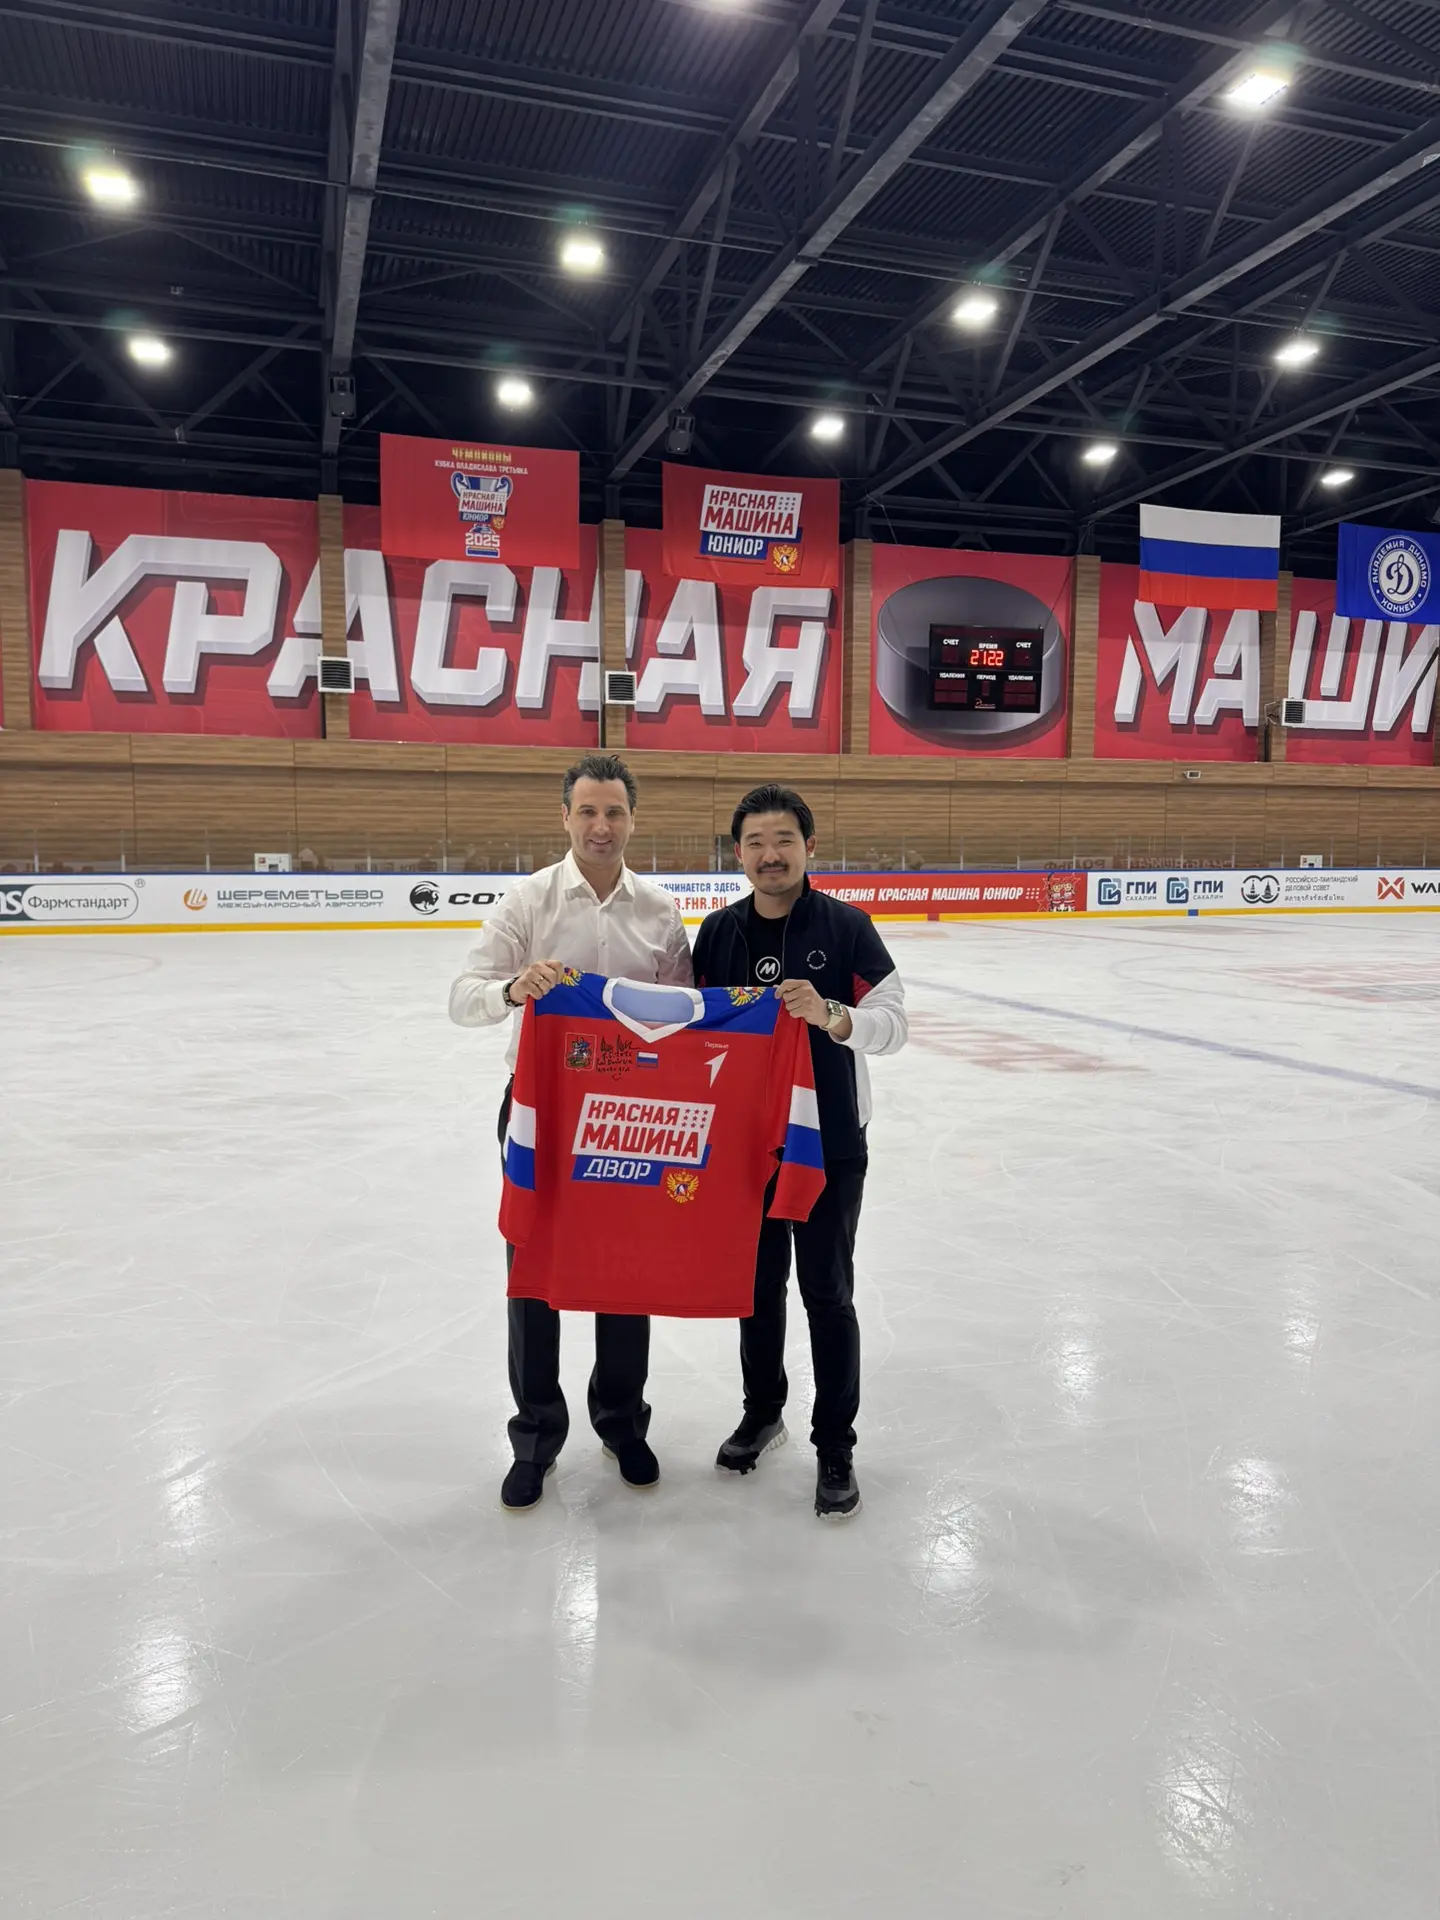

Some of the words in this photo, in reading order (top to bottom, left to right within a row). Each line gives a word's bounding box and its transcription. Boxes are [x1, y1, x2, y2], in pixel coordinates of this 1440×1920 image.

[462, 491, 496, 500] КРАСНАЯ
[709, 489, 777, 510] КРАСНАЯ
[461, 500, 504, 512] МАШИНА
[462, 513, 489, 522] ЮНИОР
[704, 506, 794, 535] МАШИНА
[465, 532, 500, 547] 2025
[708, 534, 764, 556] ЮНИОР
[1372, 540, 1404, 583] АКАДЕМИЯ
[1408, 544, 1427, 588] ДИНАМО
[1381, 598, 1416, 613] ХОККЕЙ
[37, 529, 832, 718] КРАСНАЯ
[970, 650, 1004, 666] 2122
[658, 883, 711, 892] АЧИНАЕТСЯ
[714, 882, 741, 893] ЗДЕСЬ
[1126, 882, 1157, 894] ГПИ
[1194, 880, 1223, 893] ГПИ
[217, 890, 383, 900] ШЕРЕМЕТЬЕВО
[878, 888, 929, 901] КРАСНАЯ
[932, 887, 980, 900] МАШИНА
[983, 887, 1023, 900] ЮНИОР
[28, 896, 129, 910] Фармстандарт
[218, 900, 321, 909] МЕЖДУНАРОДНЫЙ
[705, 1041, 729, 1049] Первые
[587, 1100, 680, 1126] КРАСНАЯ
[580, 1122, 699, 1158] МАШИНА
[583, 1158, 651, 1180] ДВОР
